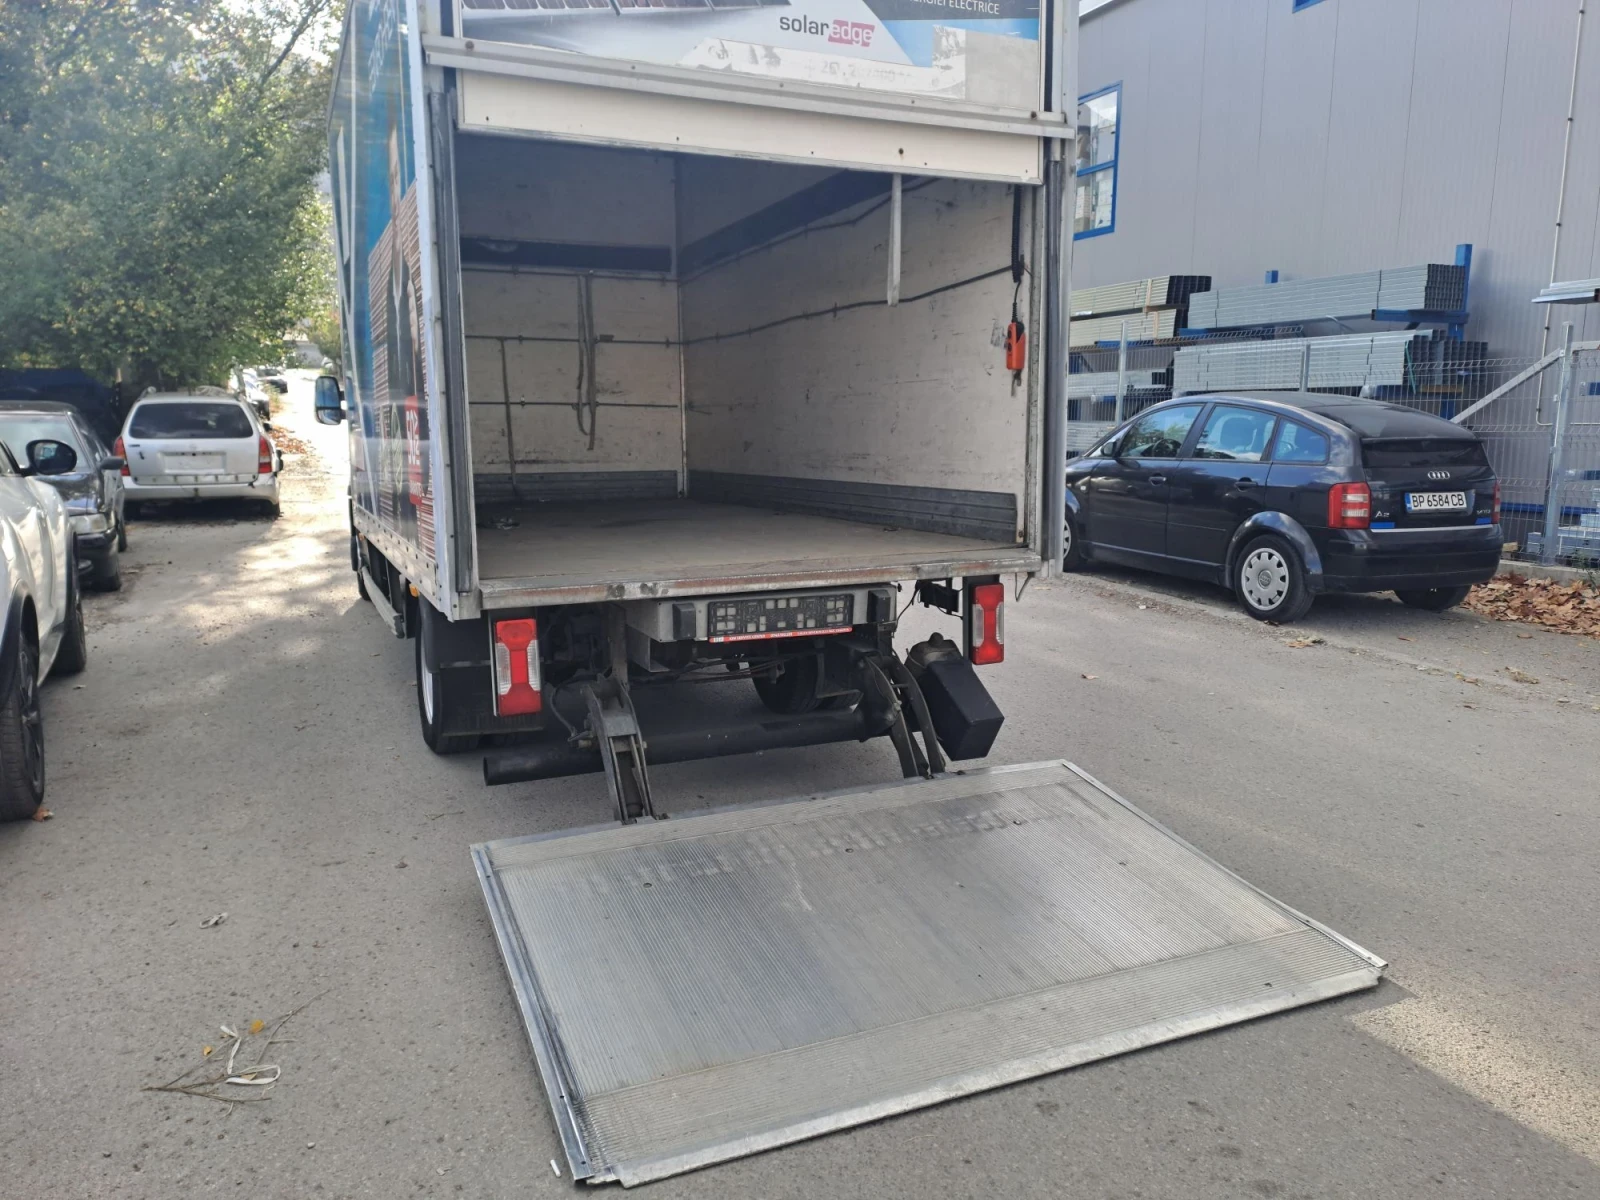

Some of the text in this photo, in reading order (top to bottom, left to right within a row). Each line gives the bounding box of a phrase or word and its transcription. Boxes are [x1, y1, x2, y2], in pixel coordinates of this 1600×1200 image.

[948, 0, 1000, 15] ELECTRICE
[779, 14, 873, 46] solaredge
[1411, 494, 1465, 508] BP 6584 CB
